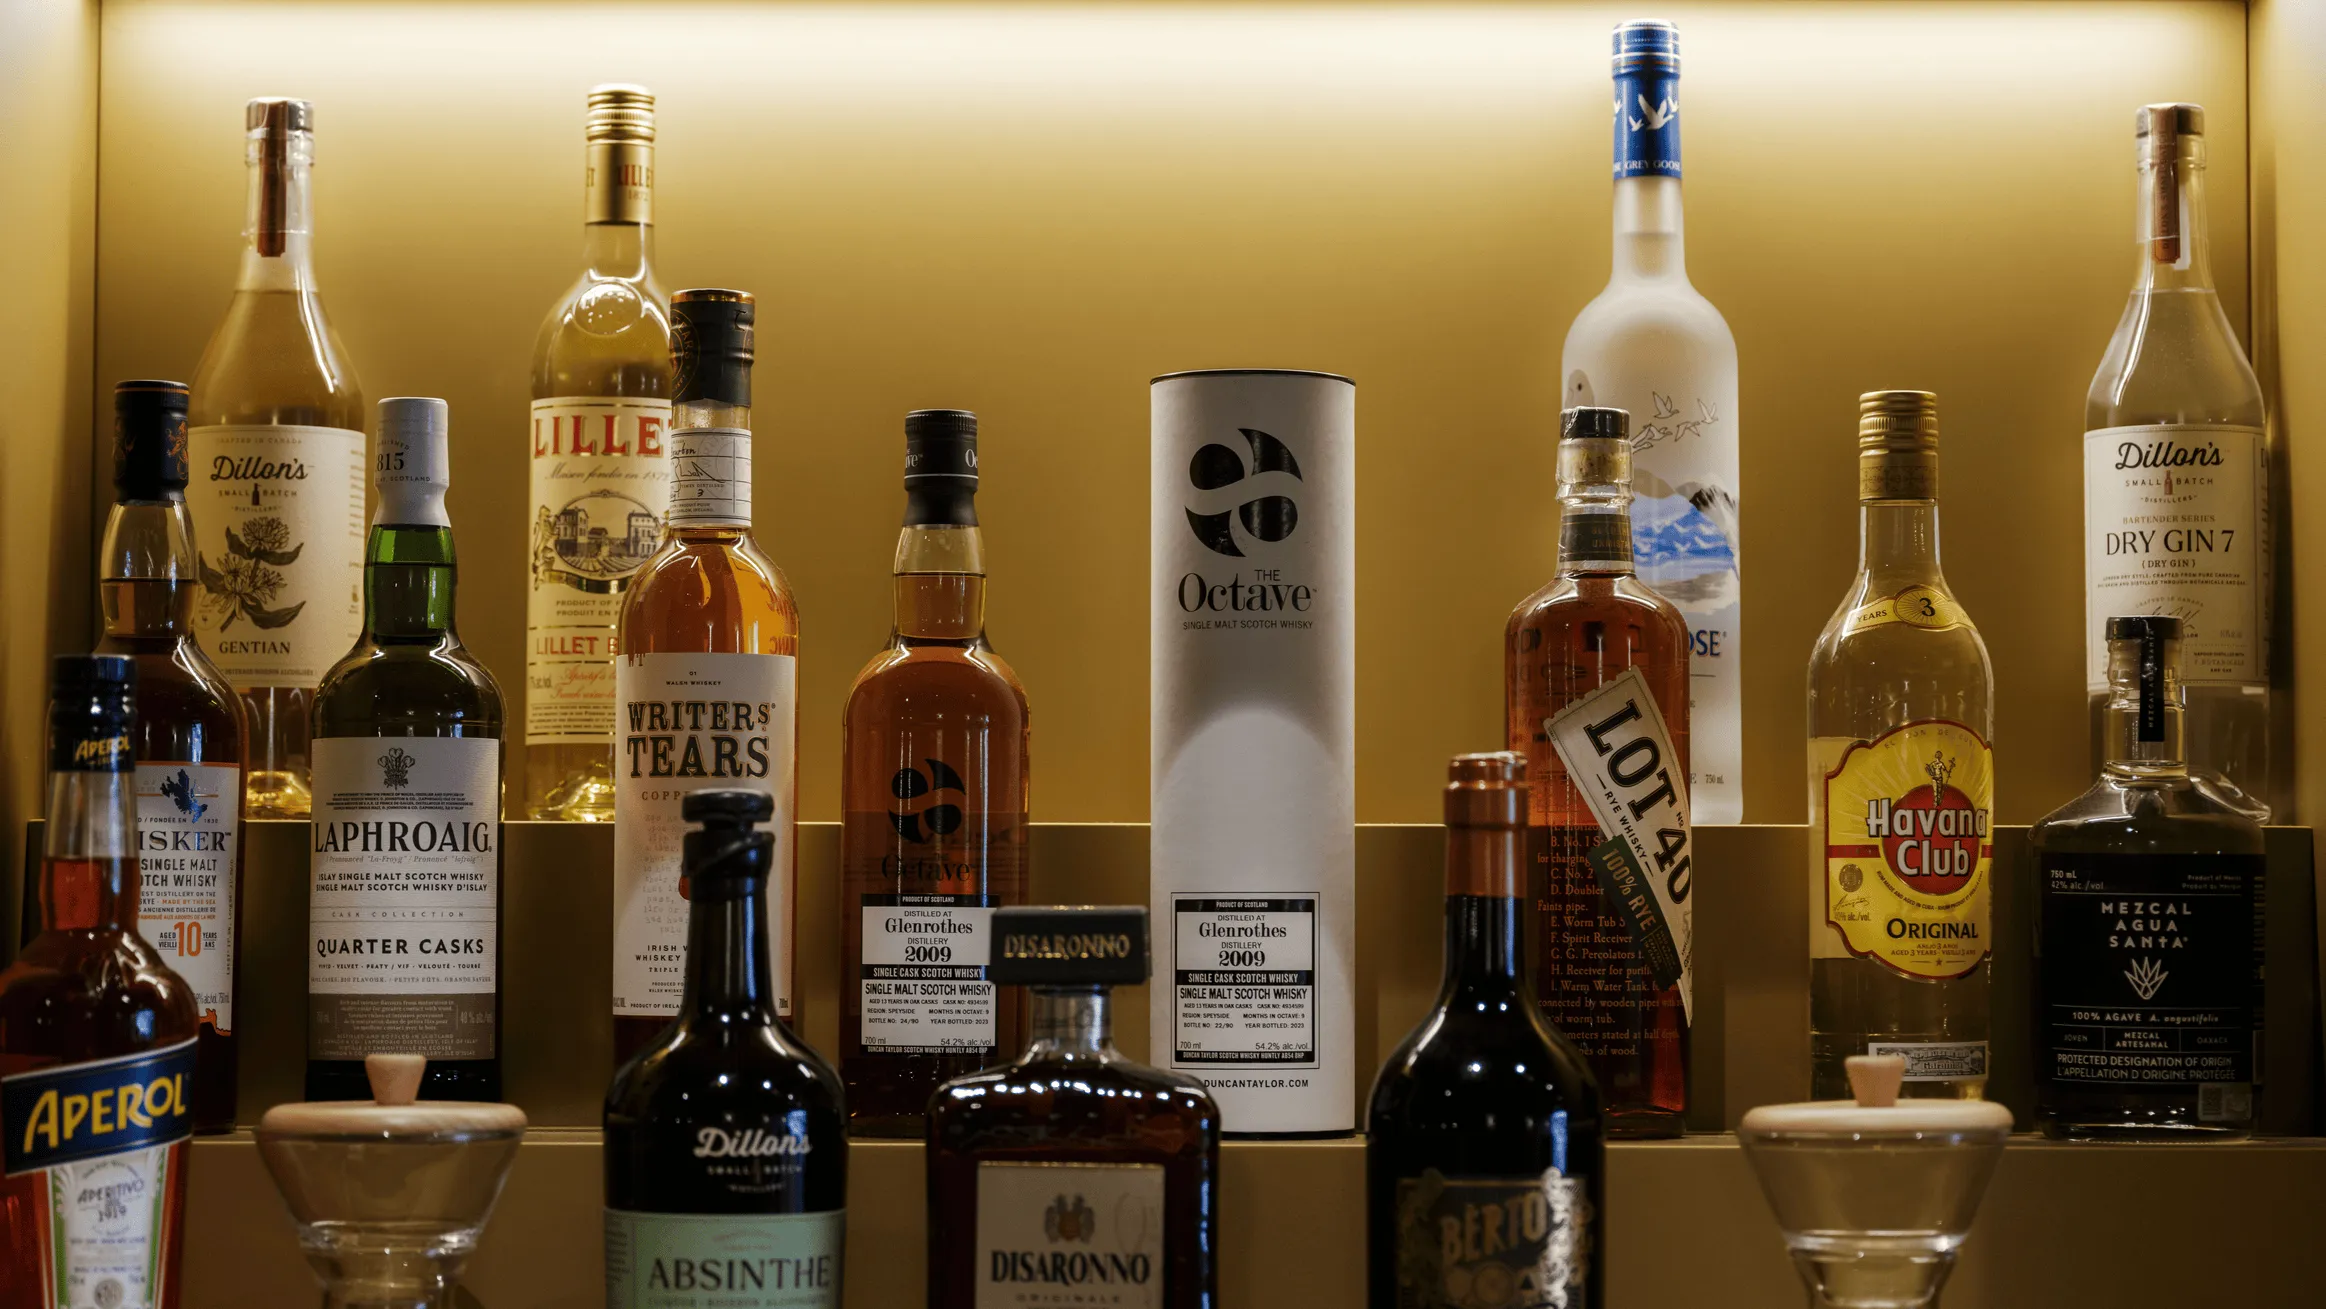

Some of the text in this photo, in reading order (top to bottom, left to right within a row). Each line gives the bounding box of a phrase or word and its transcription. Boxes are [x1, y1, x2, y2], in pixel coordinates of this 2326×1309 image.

[534, 414, 673, 459] LILLE
[2115, 441, 2224, 470] Dillon's
[210, 456, 309, 481] Dillon's
[2126, 477, 2213, 487] SMALL BATCH
[2123, 515, 2216, 524] BARTENDER SERIES
[2106, 530, 2235, 555] DRY GIN 7
[1254, 569, 1281, 581] THE
[1178, 572, 1312, 613] Octave
[1856, 597, 1936, 622] YEARS 3
[1183, 620, 1313, 629] SINGLE MALT SCOTCH WHISKY
[219, 641, 291, 654] GENTIAN
[536, 636, 599, 655] LILLET
[627, 701, 771, 732] WRITERS
[75, 734, 132, 763] APEROL
[627, 734, 770, 779] TEARS
[1584, 699, 1678, 822] LOT
[1604, 791, 1647, 859] RYE WHISKY
[1866, 797, 1988, 838] Havana
[139, 830, 226, 851] ISKER
[315, 821, 489, 853] LAPHROAIG
[141, 858, 217, 872] SINGLE MALT
[1653, 827, 1692, 905] 40
[1896, 839, 1970, 878] Club
[173, 874, 217, 887] WHISKY
[319, 873, 484, 881] ISLAY SINGLE MALT SCOTCH WHISKY
[2051, 870, 2077, 878] 750 mL
[1602, 849, 1657, 931] 100% RYE
[2051, 881, 2068, 889] 42%
[2101, 902, 2192, 915] MEZCAL
[885, 918, 973, 934] Glenrothes
[1199, 922, 1287, 937] Glenrothes
[1564, 917, 1617, 927] Worm Tub
[1886, 917, 1979, 939] ORIGINAL
[2115, 919, 2178, 931] AGUA
[173, 921, 202, 957] 10
[1594, 933, 1633, 943] Receiver
[317, 939, 484, 957] QUARTER CASKS
[905, 946, 952, 962] 2009
[1004, 934, 1131, 960] DISARONNO
[1219, 950, 1265, 966] 2009
[873, 968, 983, 978] SINGLE CASK SCOTCH WHISKY
[1188, 974, 1298, 983] SINGLE CASK SCOTCH WHISKY
[865, 984, 992, 995] SINGLE MALT SCOTCH WHISKY
[1180, 988, 1307, 999] SINGLE MALT SCOTCH WHISKY
[2072, 1012, 2100, 1020] 100%
[2105, 1013, 2141, 1021] AGAVE
[2150, 1014, 2160, 1022] A.
[2064, 1034, 2088, 1042] JOVEN
[2124, 1032, 2160, 1040] MEZCAL
[2196, 1036, 2228, 1044] OAXACA
[1180, 1041, 1191, 1049] 700
[1255, 1042, 1280, 1050] 54.2%
[2057, 1054, 2232, 1066] PROTECTED DESIGNATION OF ORIGIN
[2057, 1067, 2235, 1079] L'APPELLATION D'ORIGINE PROTÉGÉE
[23, 1073, 186, 1154] APEROL
[77, 1179, 145, 1205] APERITIVO
[648, 1256, 831, 1291] ABSINTHE
[991, 1251, 1151, 1287] DISARONNO
